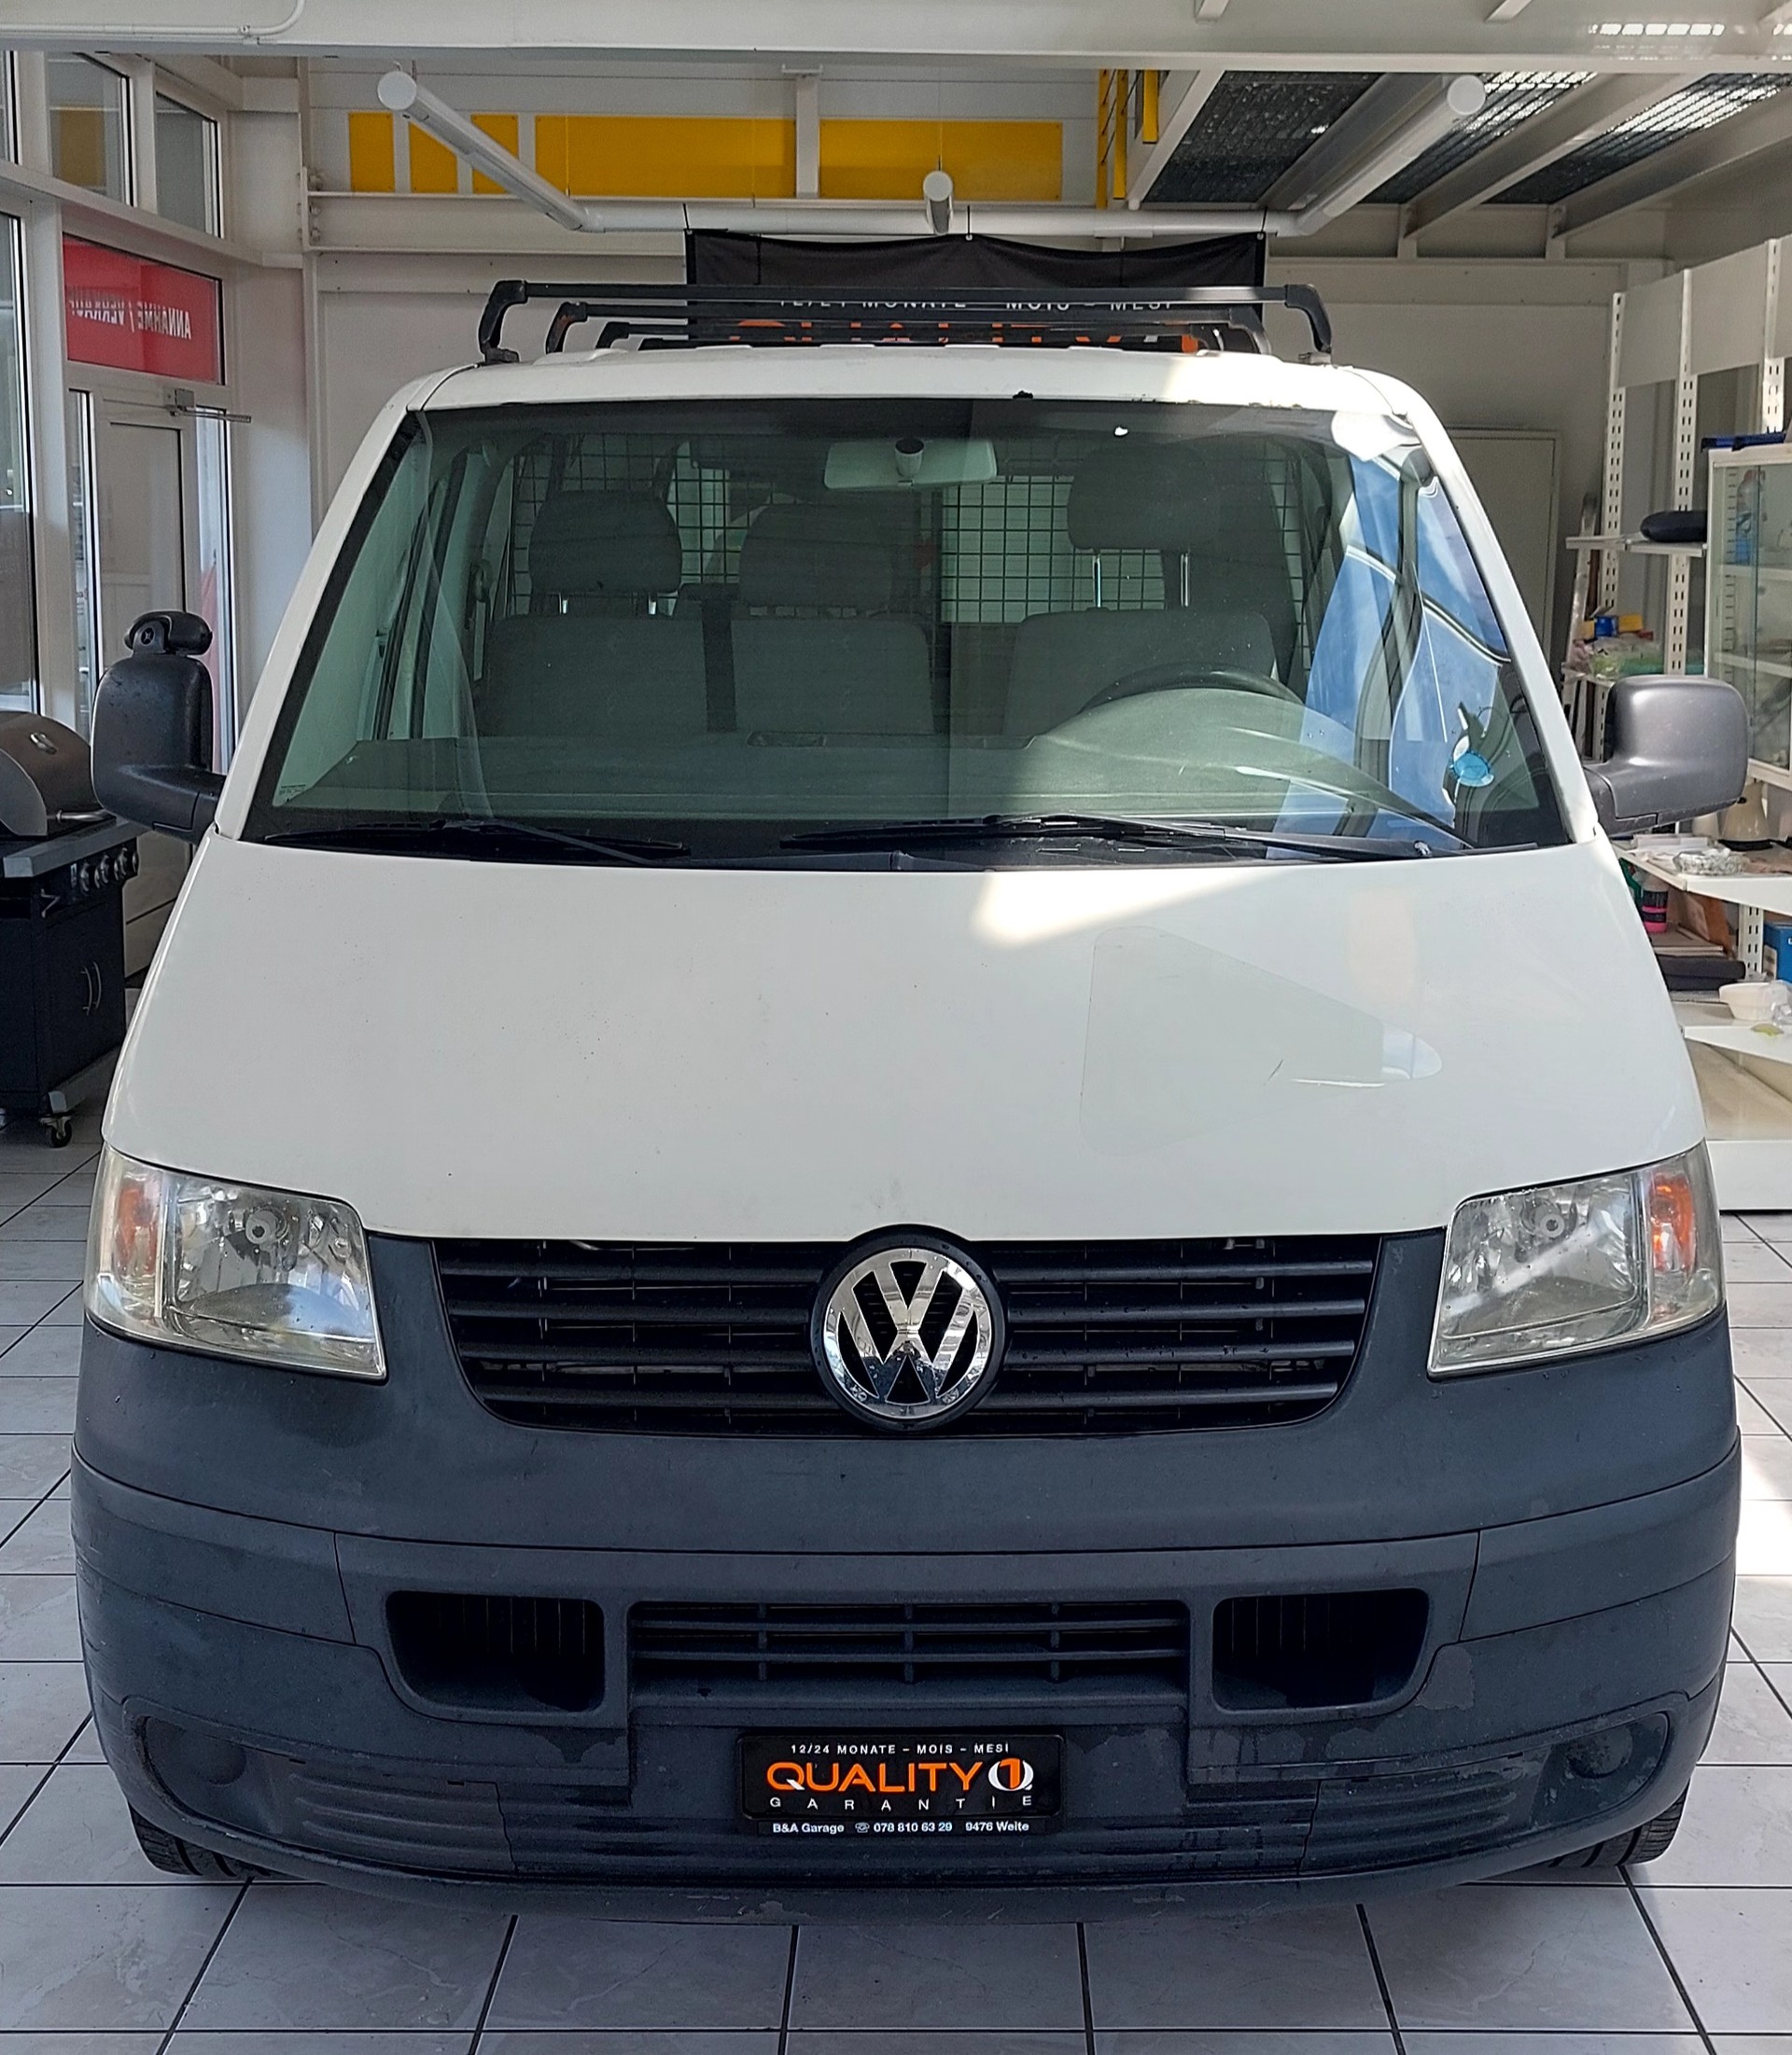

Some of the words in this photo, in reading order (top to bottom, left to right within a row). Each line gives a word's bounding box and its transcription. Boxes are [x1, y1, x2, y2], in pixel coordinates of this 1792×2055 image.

[791, 1743, 830, 1754] 12/24
[837, 1744, 896, 1755] MONATE
[917, 1743, 953, 1755] MOIS
[973, 1742, 1009, 1754] MESI
[766, 1762, 983, 1793] QUALITY
[769, 1796, 1032, 1812] GARANTIE
[772, 1823, 799, 1834] B&A
[801, 1823, 845, 1835] Garage
[873, 1822, 895, 1833] 078
[897, 1822, 918, 1833] 810
[921, 1822, 935, 1832] 63
[938, 1822, 953, 1832] 29
[965, 1822, 994, 1832] 9476
